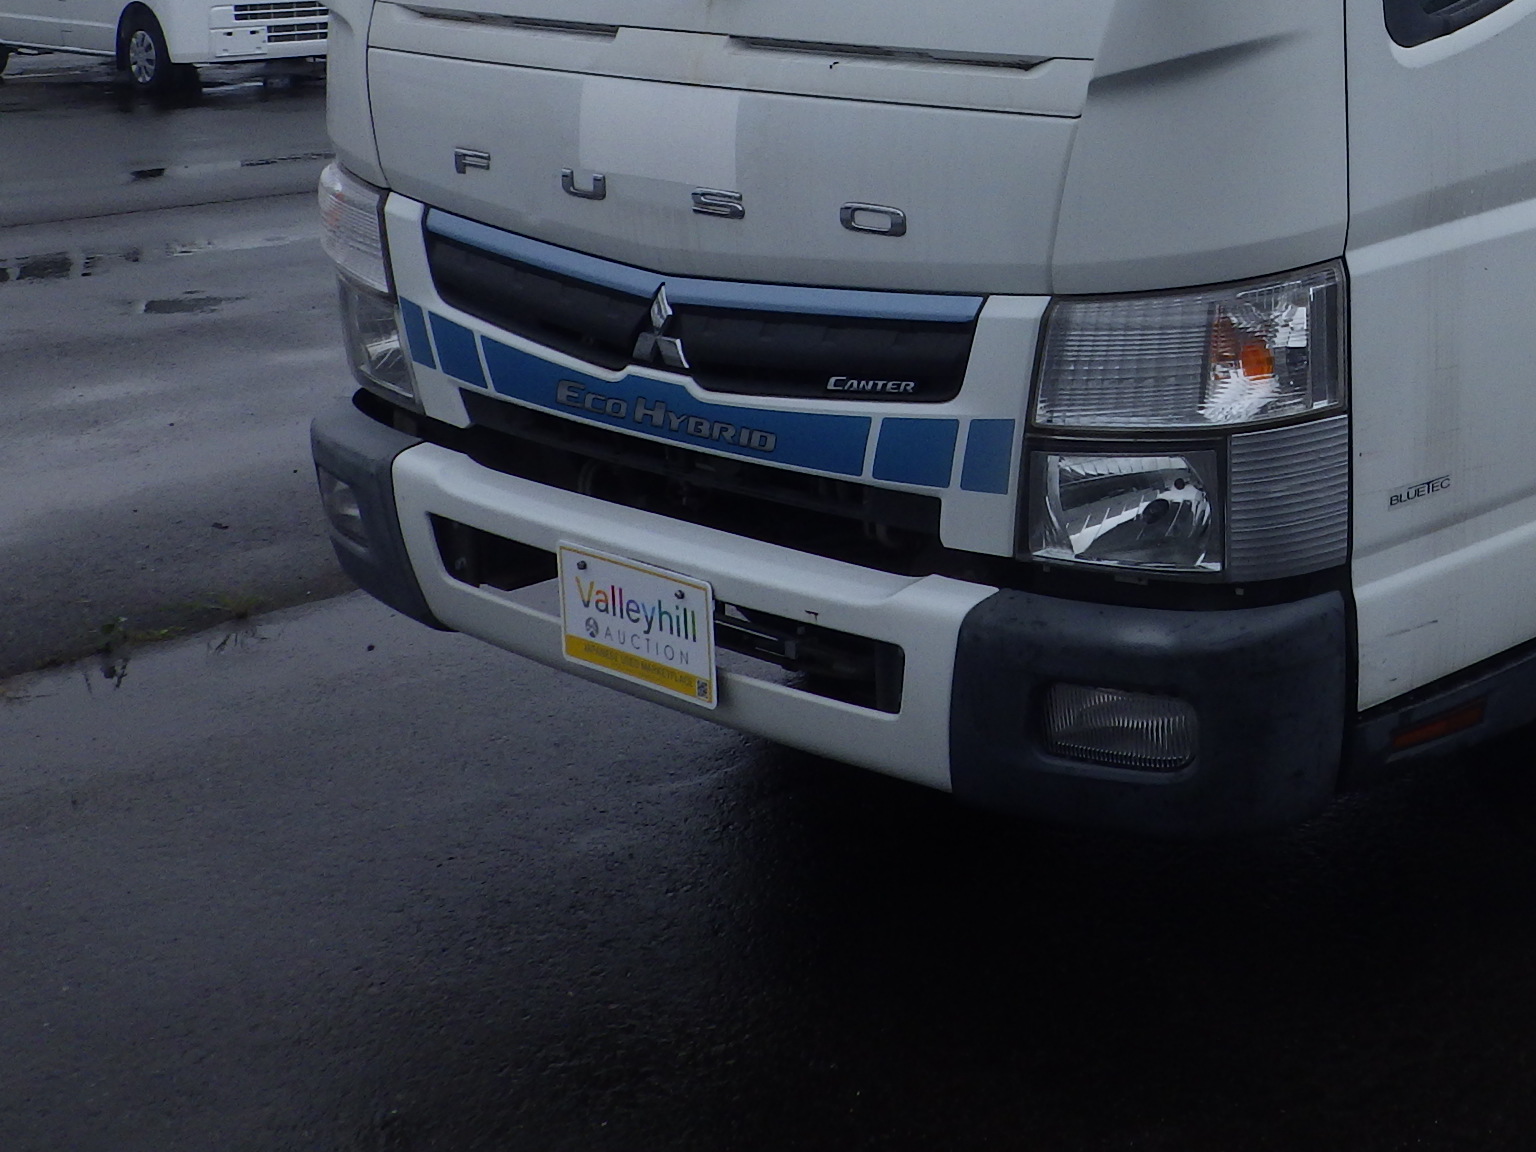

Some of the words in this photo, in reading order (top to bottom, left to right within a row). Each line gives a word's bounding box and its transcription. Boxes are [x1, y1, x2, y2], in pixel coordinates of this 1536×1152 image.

[454, 147, 907, 237] FUSO
[826, 376, 915, 393] CANTER
[1389, 474, 1451, 506] BLUETEC
[575, 576, 697, 643] Valleyhill
[604, 625, 690, 665] AUCTION
